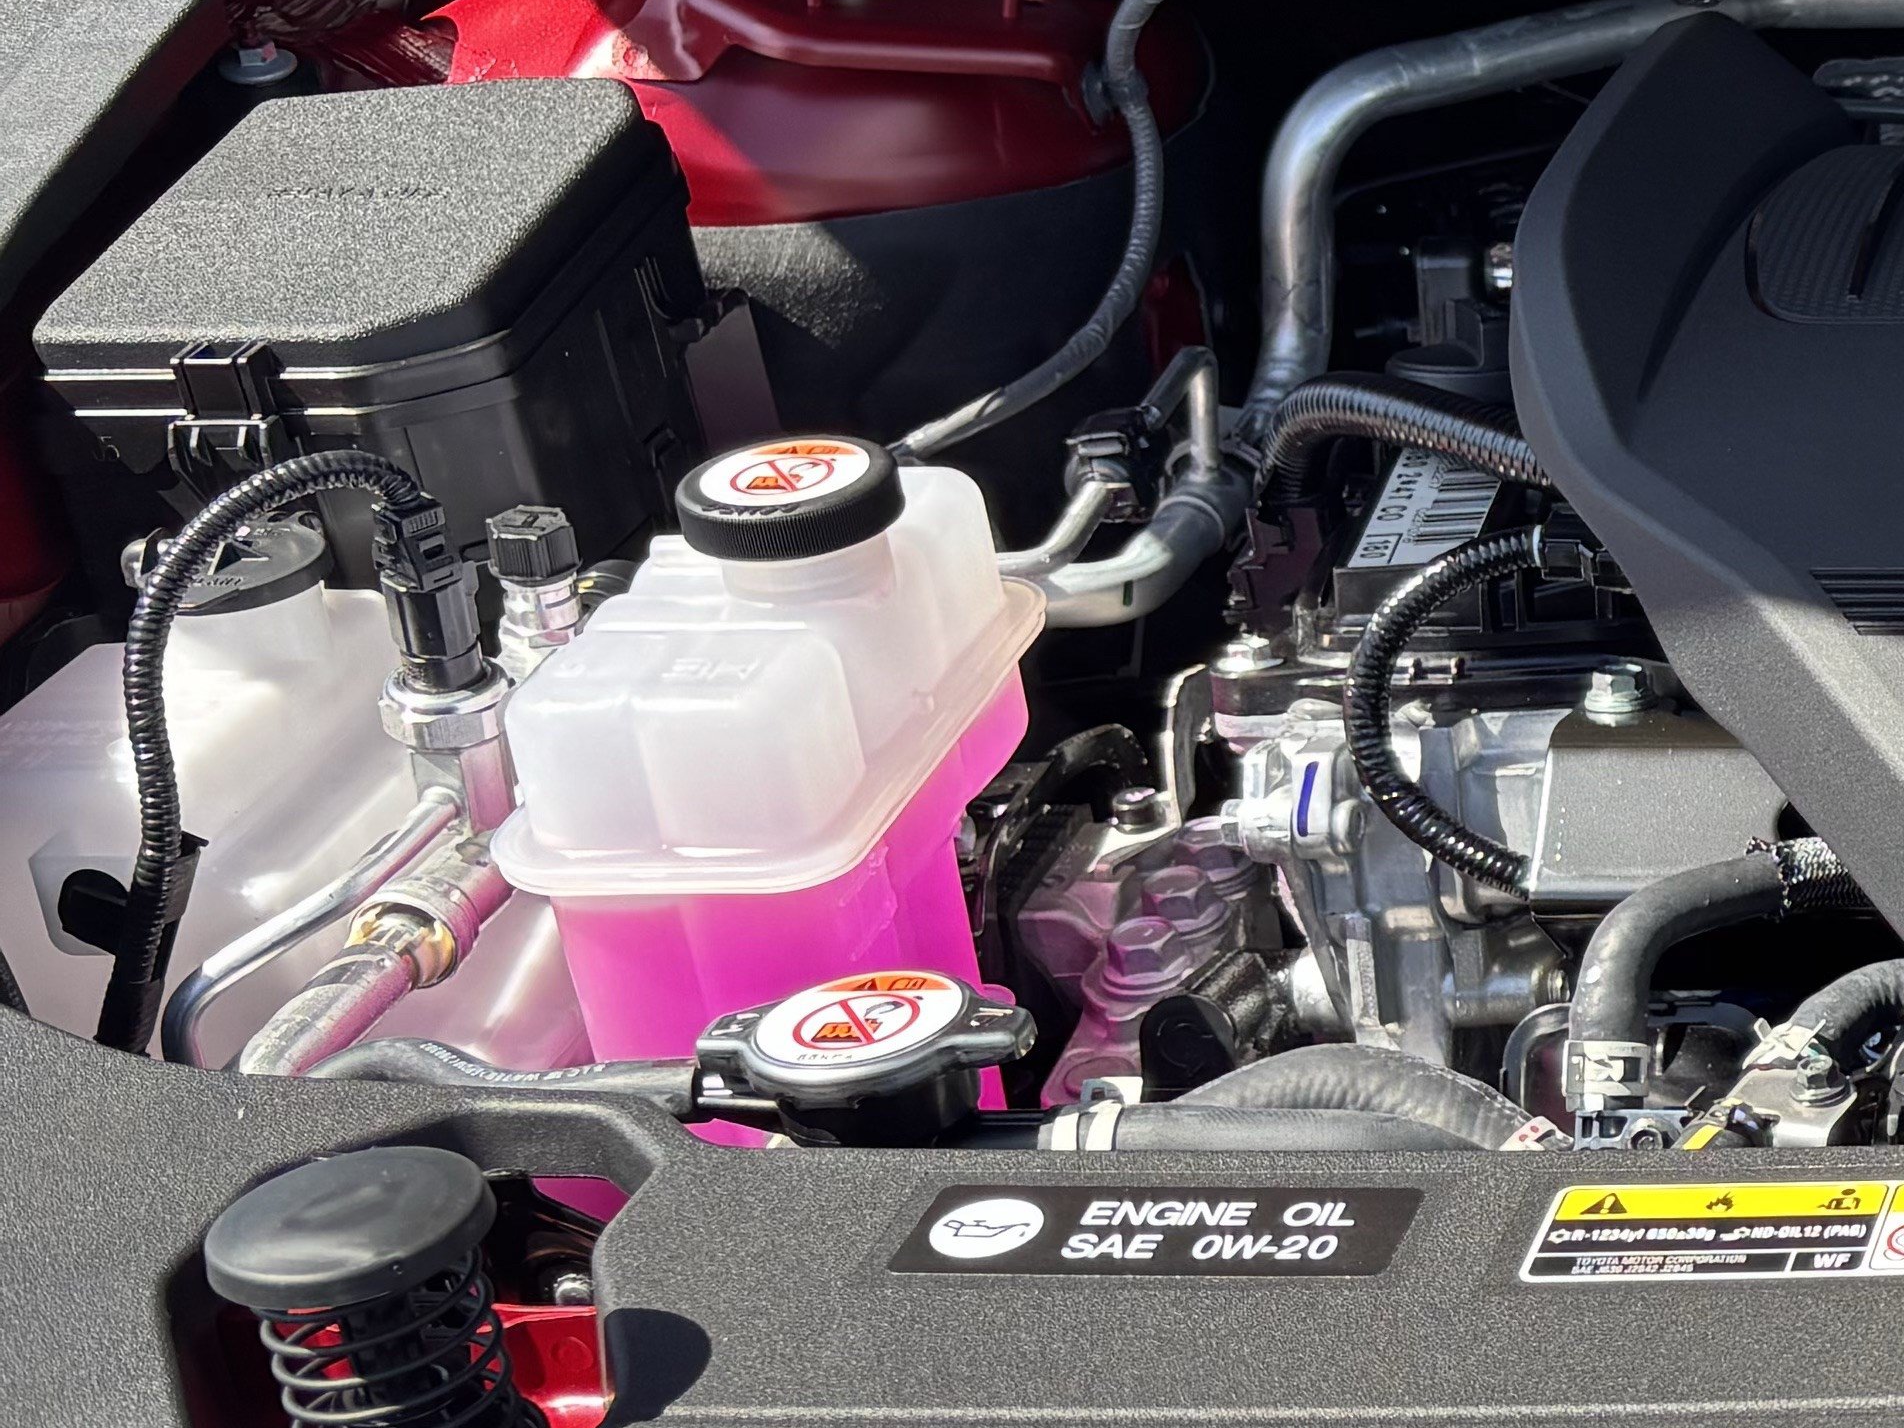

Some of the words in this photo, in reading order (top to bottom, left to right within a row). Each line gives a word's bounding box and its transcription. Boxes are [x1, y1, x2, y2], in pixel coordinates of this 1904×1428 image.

[1080, 1200, 1257, 1227] ENGINE
[1281, 1201, 1356, 1228] OIL
[1060, 1233, 1164, 1260] SAE
[1191, 1233, 1339, 1260] 0W-20
[1813, 1253, 1852, 1269] WF
